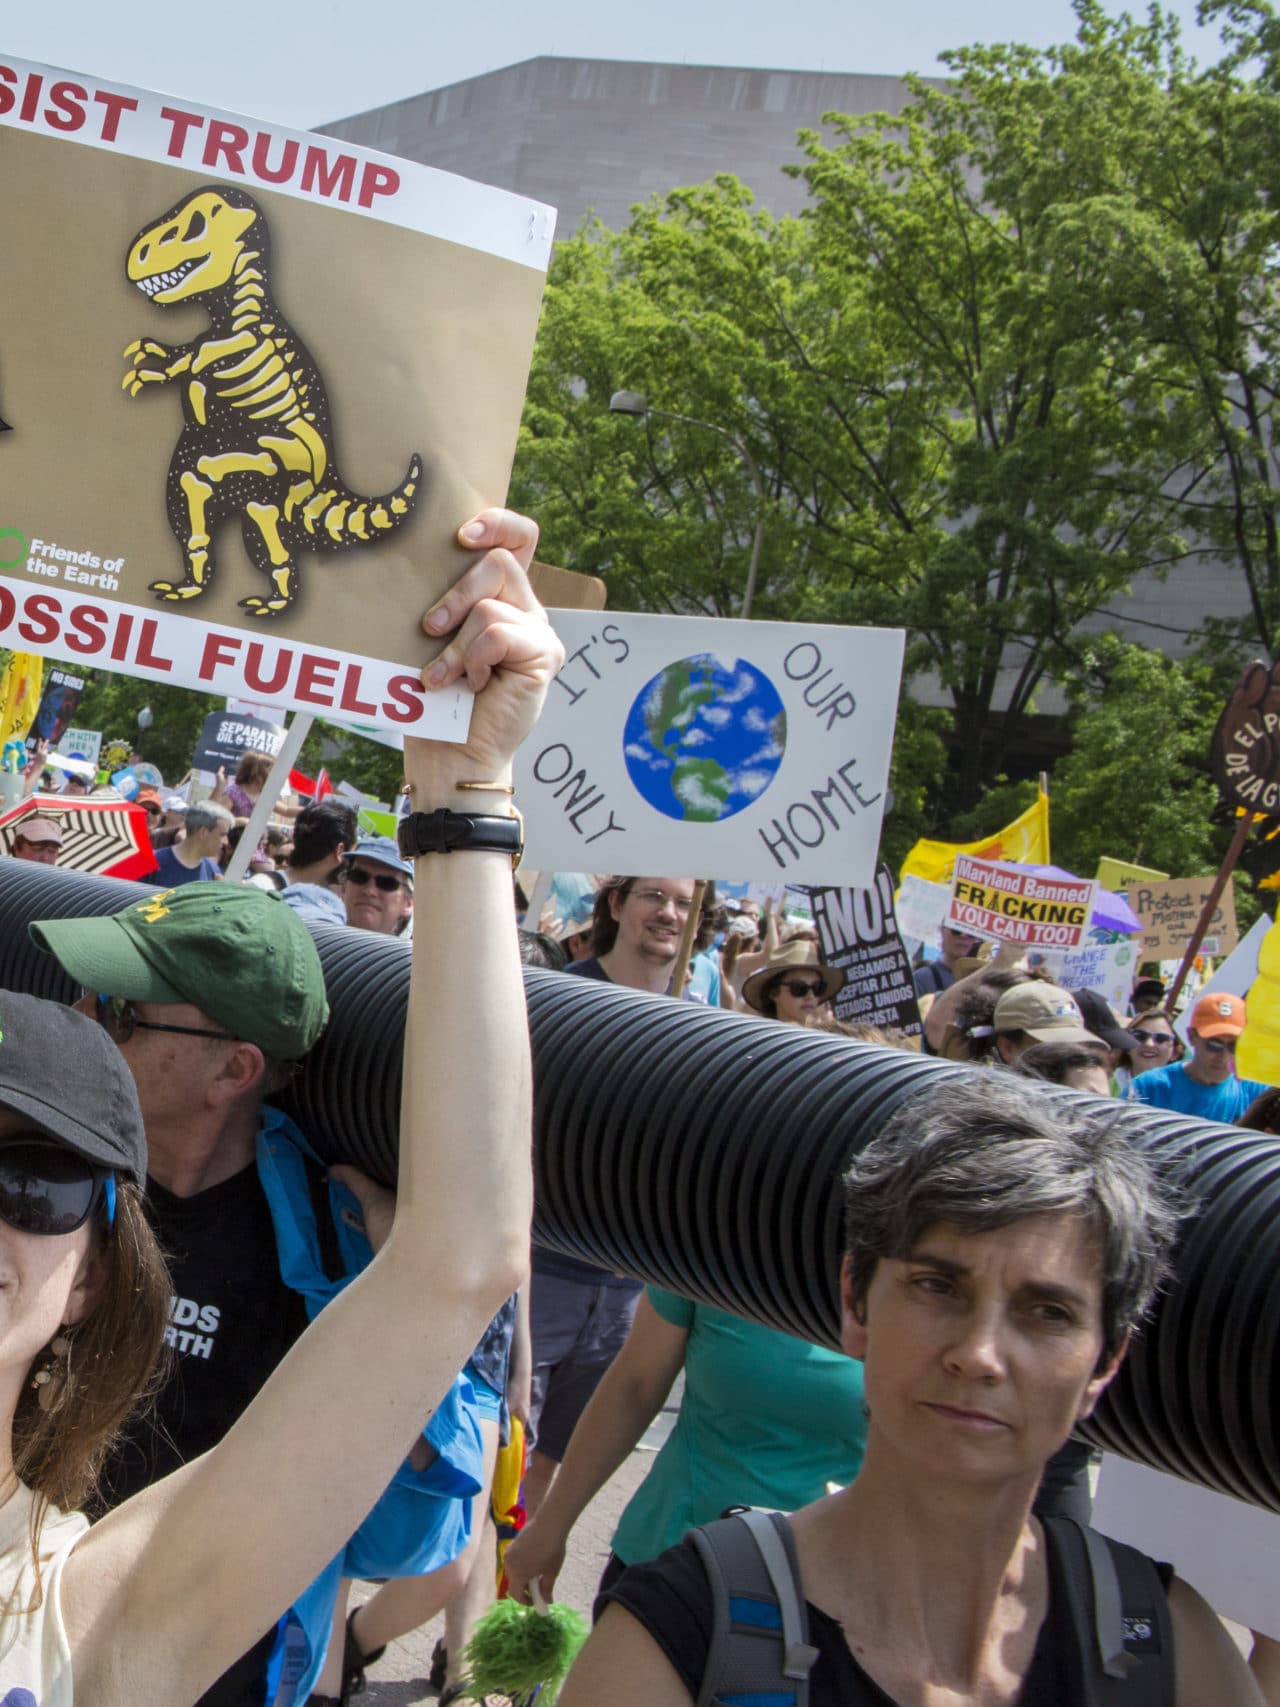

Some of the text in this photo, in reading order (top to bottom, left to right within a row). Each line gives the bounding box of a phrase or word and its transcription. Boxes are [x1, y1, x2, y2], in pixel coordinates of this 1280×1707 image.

[160, 106, 402, 210] TRUMP
[30, 539, 124, 574] Friends of
[26, 557, 119, 592] the Earth
[50, 670, 65, 684] NO
[198, 632, 427, 724] FUELS
[553, 624, 857, 732] IT'S OUR
[216, 731, 233, 745] OIL
[244, 736, 278, 757] STATE
[218, 720, 281, 746] SEPARATE
[1234, 722, 1264, 748] EL
[1225, 753, 1265, 802] DE LA
[533, 743, 882, 869] ONLY HOME
[957, 859, 1091, 904] Maryland Banned
[954, 881, 1086, 925] FRACKING
[1137, 888, 1194, 914] Protect
[954, 902, 990, 929] YOU
[993, 918, 1030, 941] CAN
[1034, 924, 1075, 945] TOO!
[898, 953, 907, 968] A
[1072, 964, 1097, 976] THE
[881, 975, 890, 989] A
[890, 969, 906, 986] UN
[834, 985, 914, 1019] ESTADOS UNIDOS
